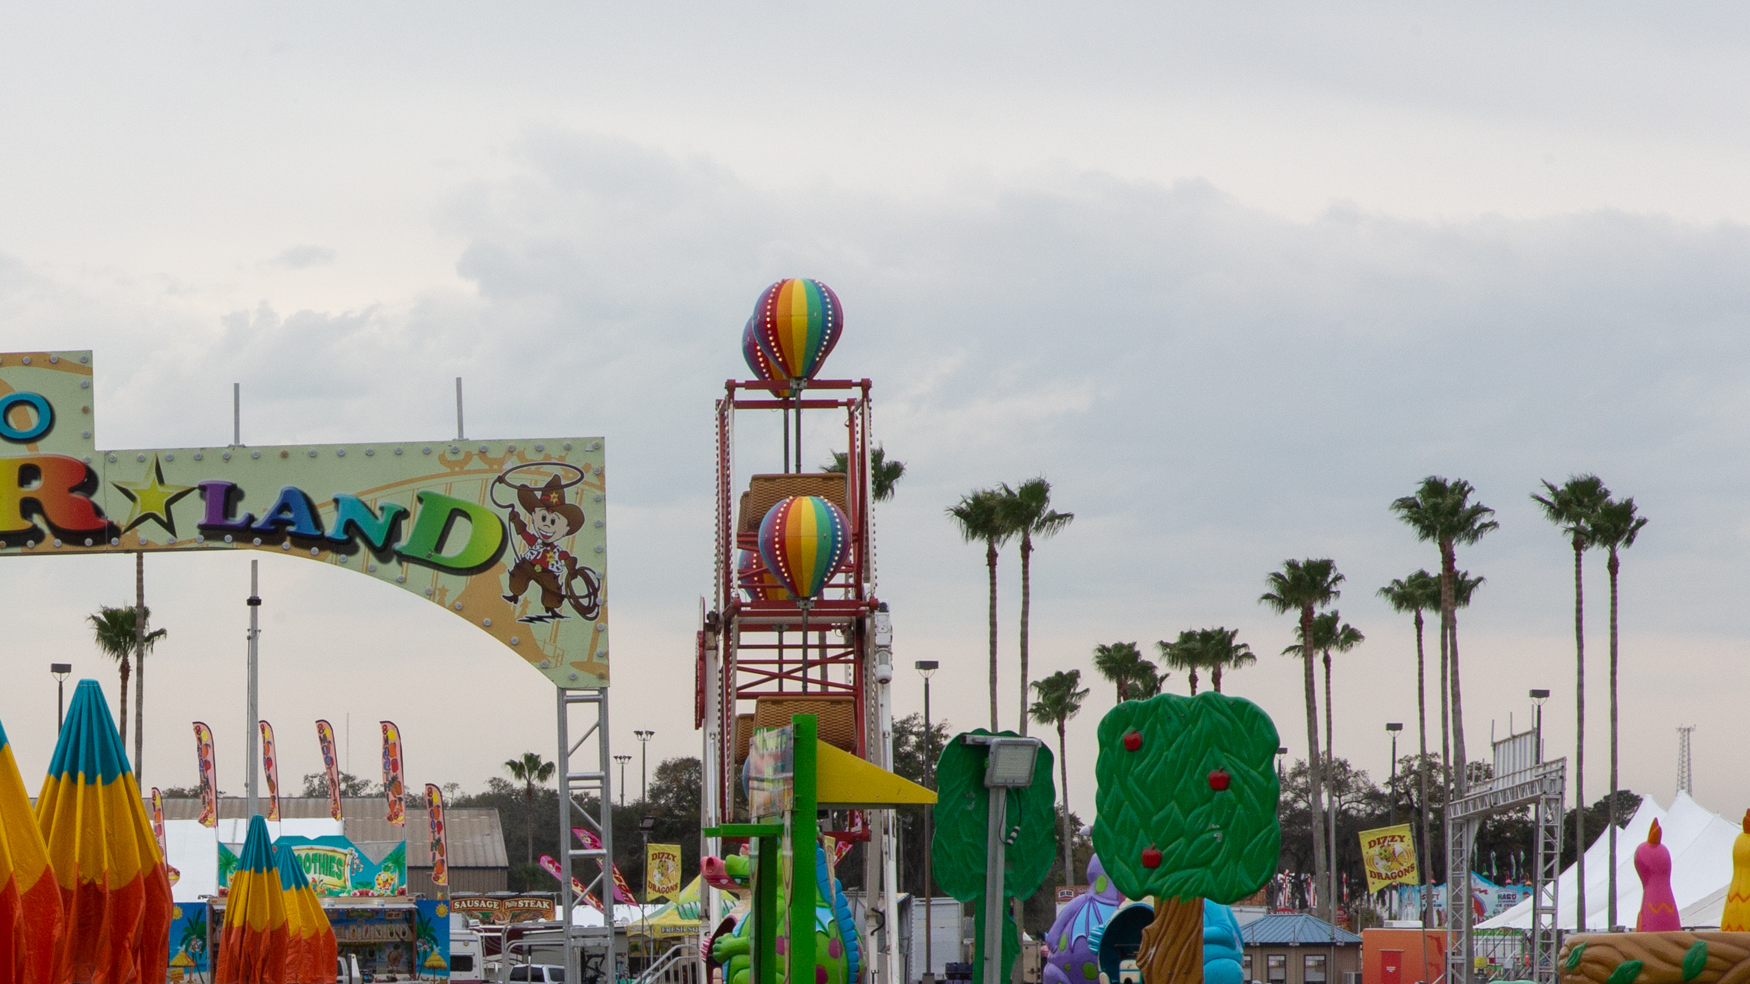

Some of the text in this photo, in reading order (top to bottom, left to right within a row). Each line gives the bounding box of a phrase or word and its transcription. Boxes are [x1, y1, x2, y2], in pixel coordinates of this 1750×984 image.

[197, 480, 508, 576] LAND
[1367, 835, 1406, 849] DIZZY
[651, 852, 677, 861] DIZZY
[1369, 863, 1415, 881] DRAGONS
[648, 881, 679, 895] DRAGONS
[454, 899, 500, 909] SAUSAGE
[518, 899, 550, 909] STEAK
